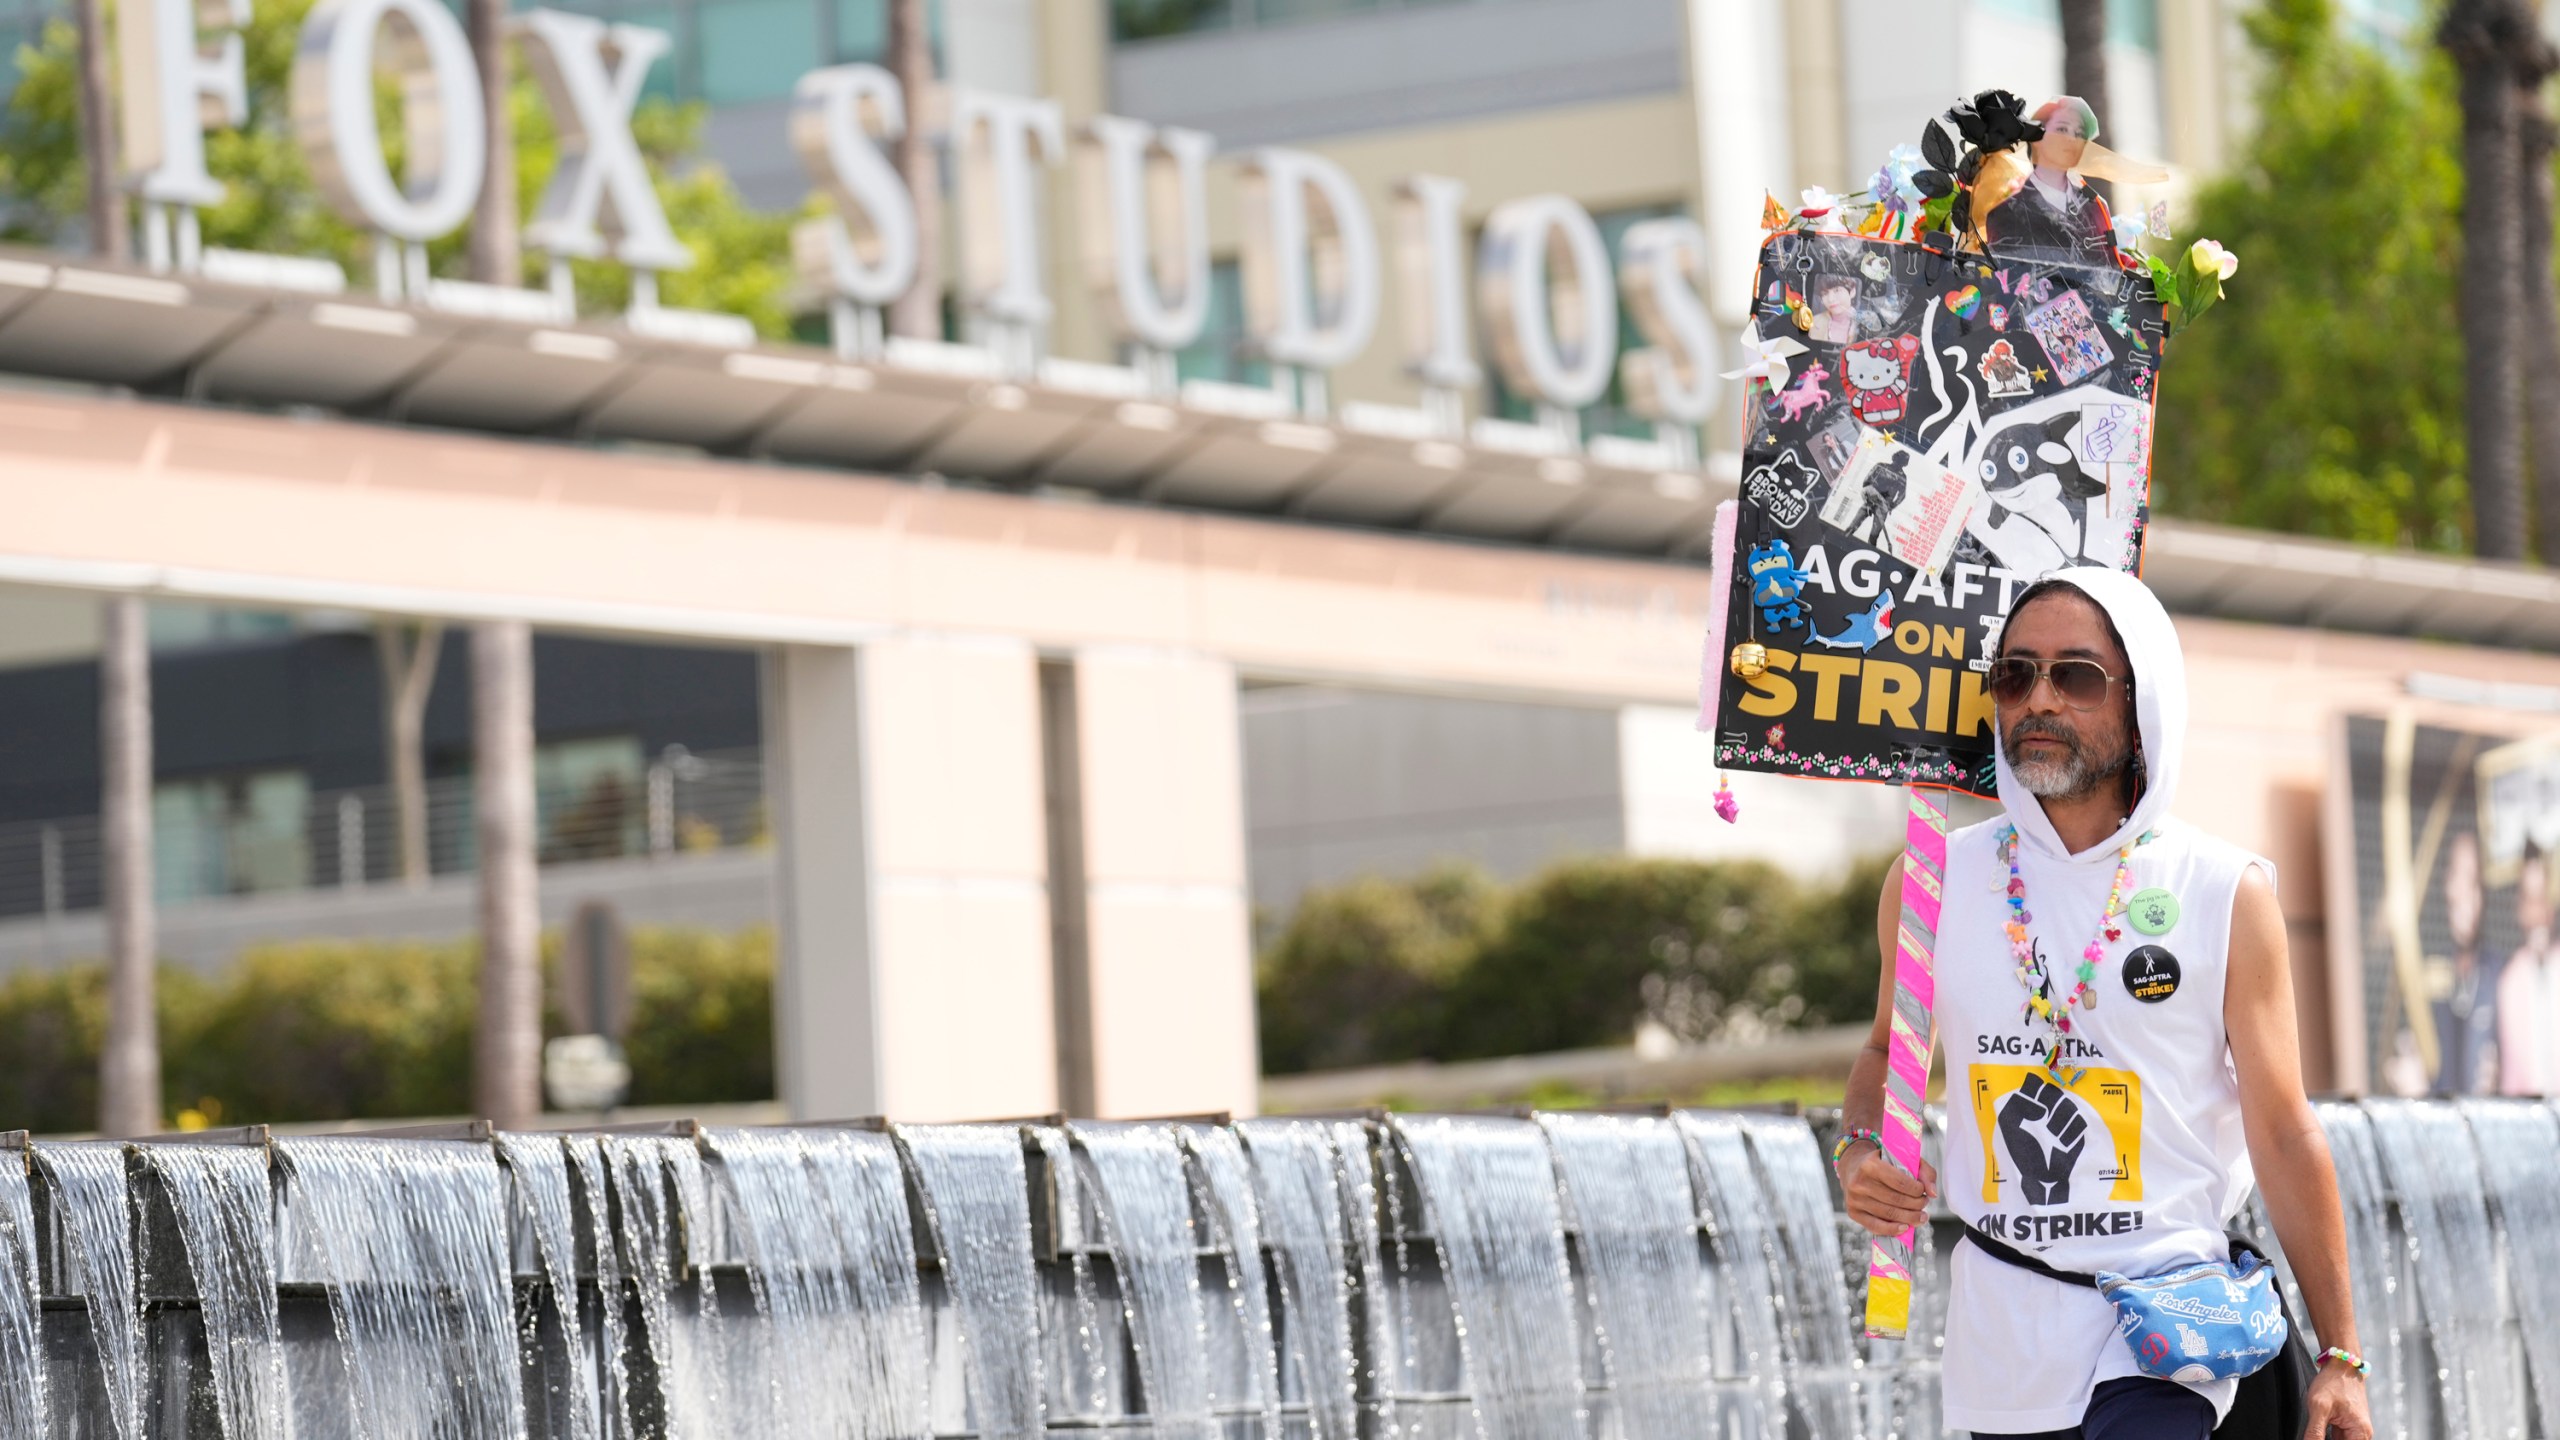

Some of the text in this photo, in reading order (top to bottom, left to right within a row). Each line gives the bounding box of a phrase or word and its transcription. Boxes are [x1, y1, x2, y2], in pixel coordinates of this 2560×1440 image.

[122, 0, 1720, 422] FOX STUDIOS
[1754, 472, 1803, 516] BROWNIE
[1894, 620, 1966, 661] ON
[1738, 648, 1996, 738] STRIK
[2135, 983, 2174, 998] STRIKE!
[1977, 1035, 2104, 1058] SAG·ATRA
[2013, 1210, 2143, 1242] STRIKE!
[2152, 1290, 2242, 1324] Los Angeles
[2175, 1323, 2209, 1357] LA
